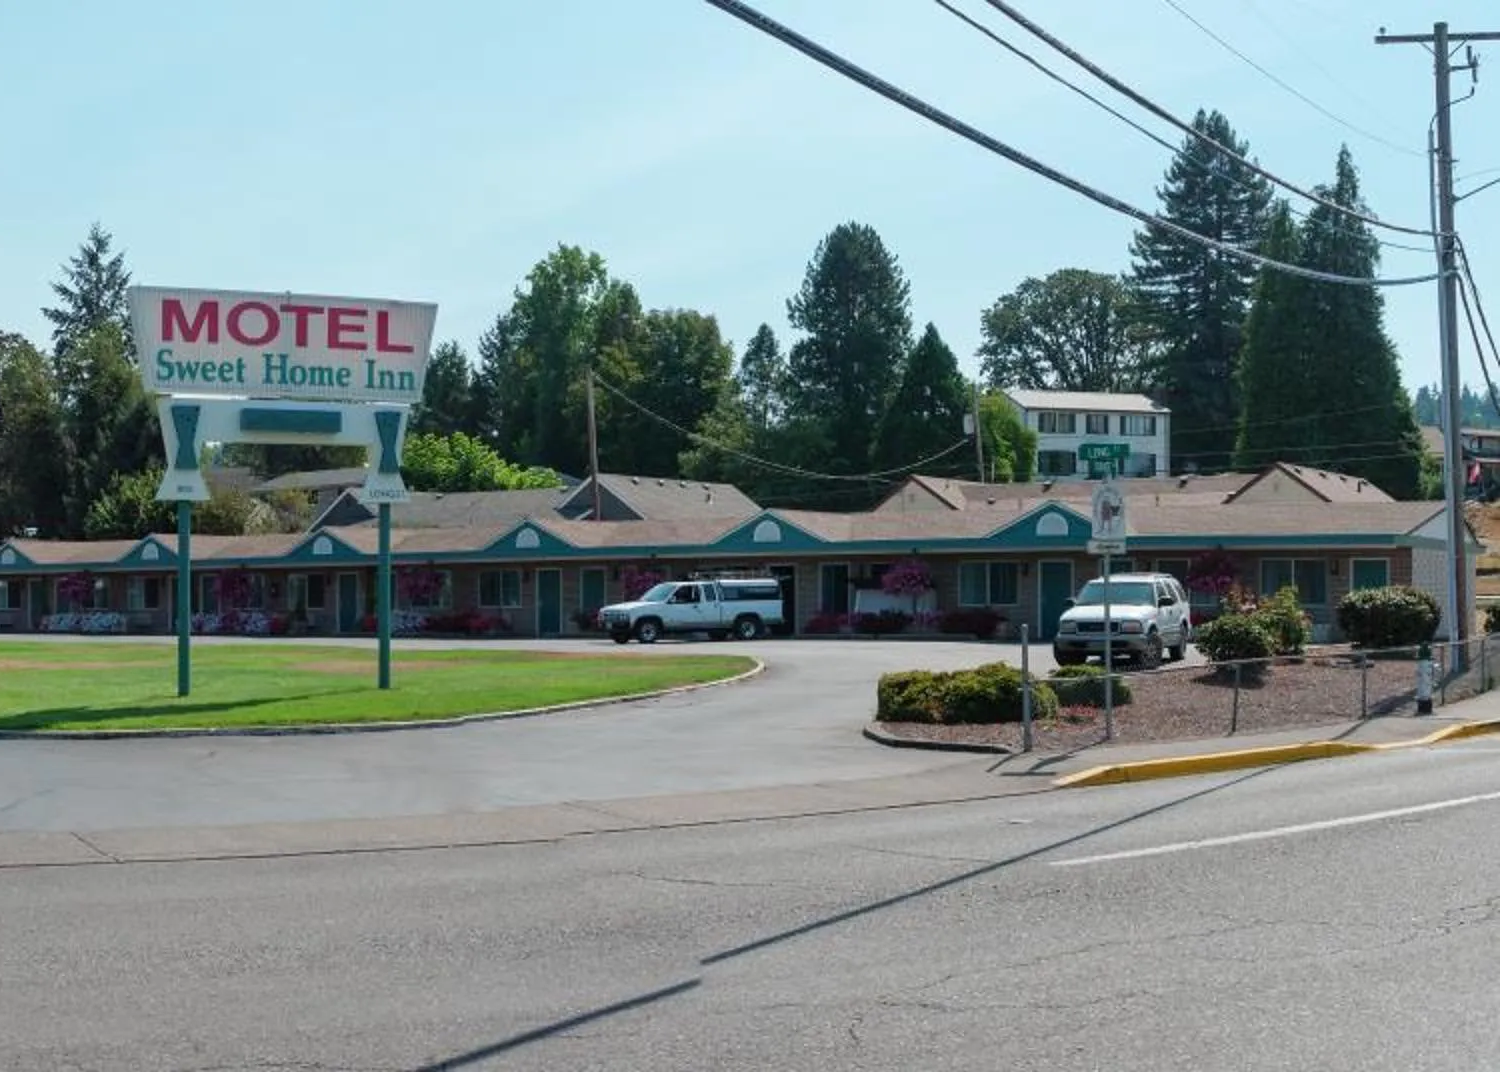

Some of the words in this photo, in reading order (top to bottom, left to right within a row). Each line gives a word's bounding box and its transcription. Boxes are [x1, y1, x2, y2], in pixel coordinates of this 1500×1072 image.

[162, 299, 414, 352] MOTEL
[157, 349, 245, 383] Sweet
[263, 353, 351, 386] Home
[365, 358, 414, 390] Inn
